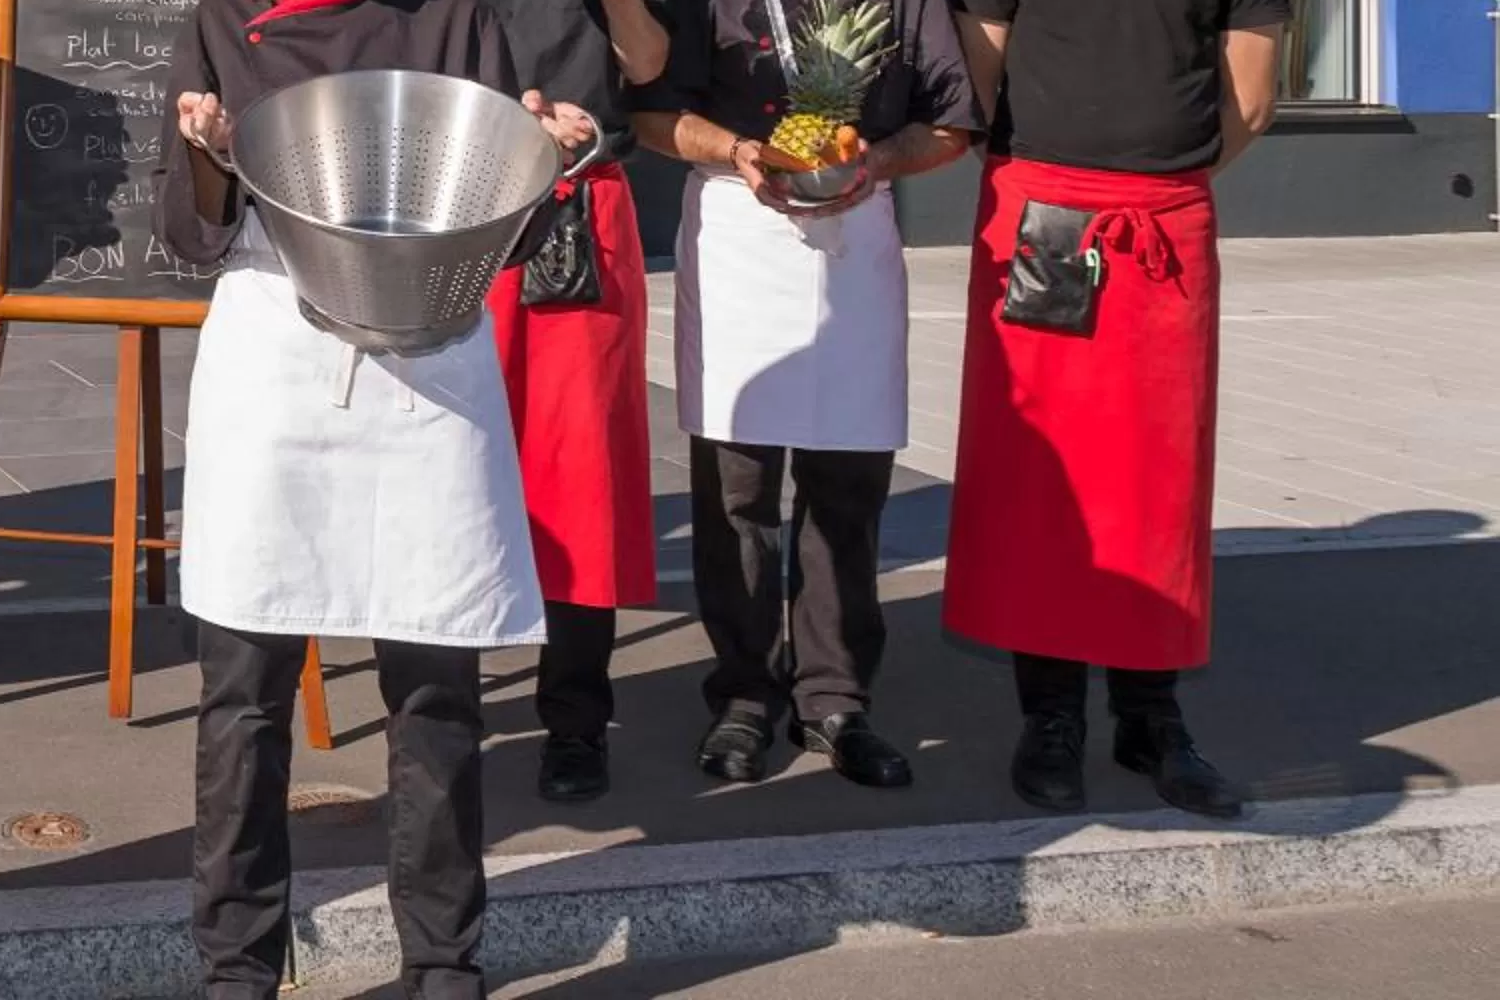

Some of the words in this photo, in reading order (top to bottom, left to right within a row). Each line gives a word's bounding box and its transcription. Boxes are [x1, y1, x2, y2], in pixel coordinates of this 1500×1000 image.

[67, 28, 116, 59] Plat
[135, 31, 173, 57] loc
[53, 233, 125, 280] BON
